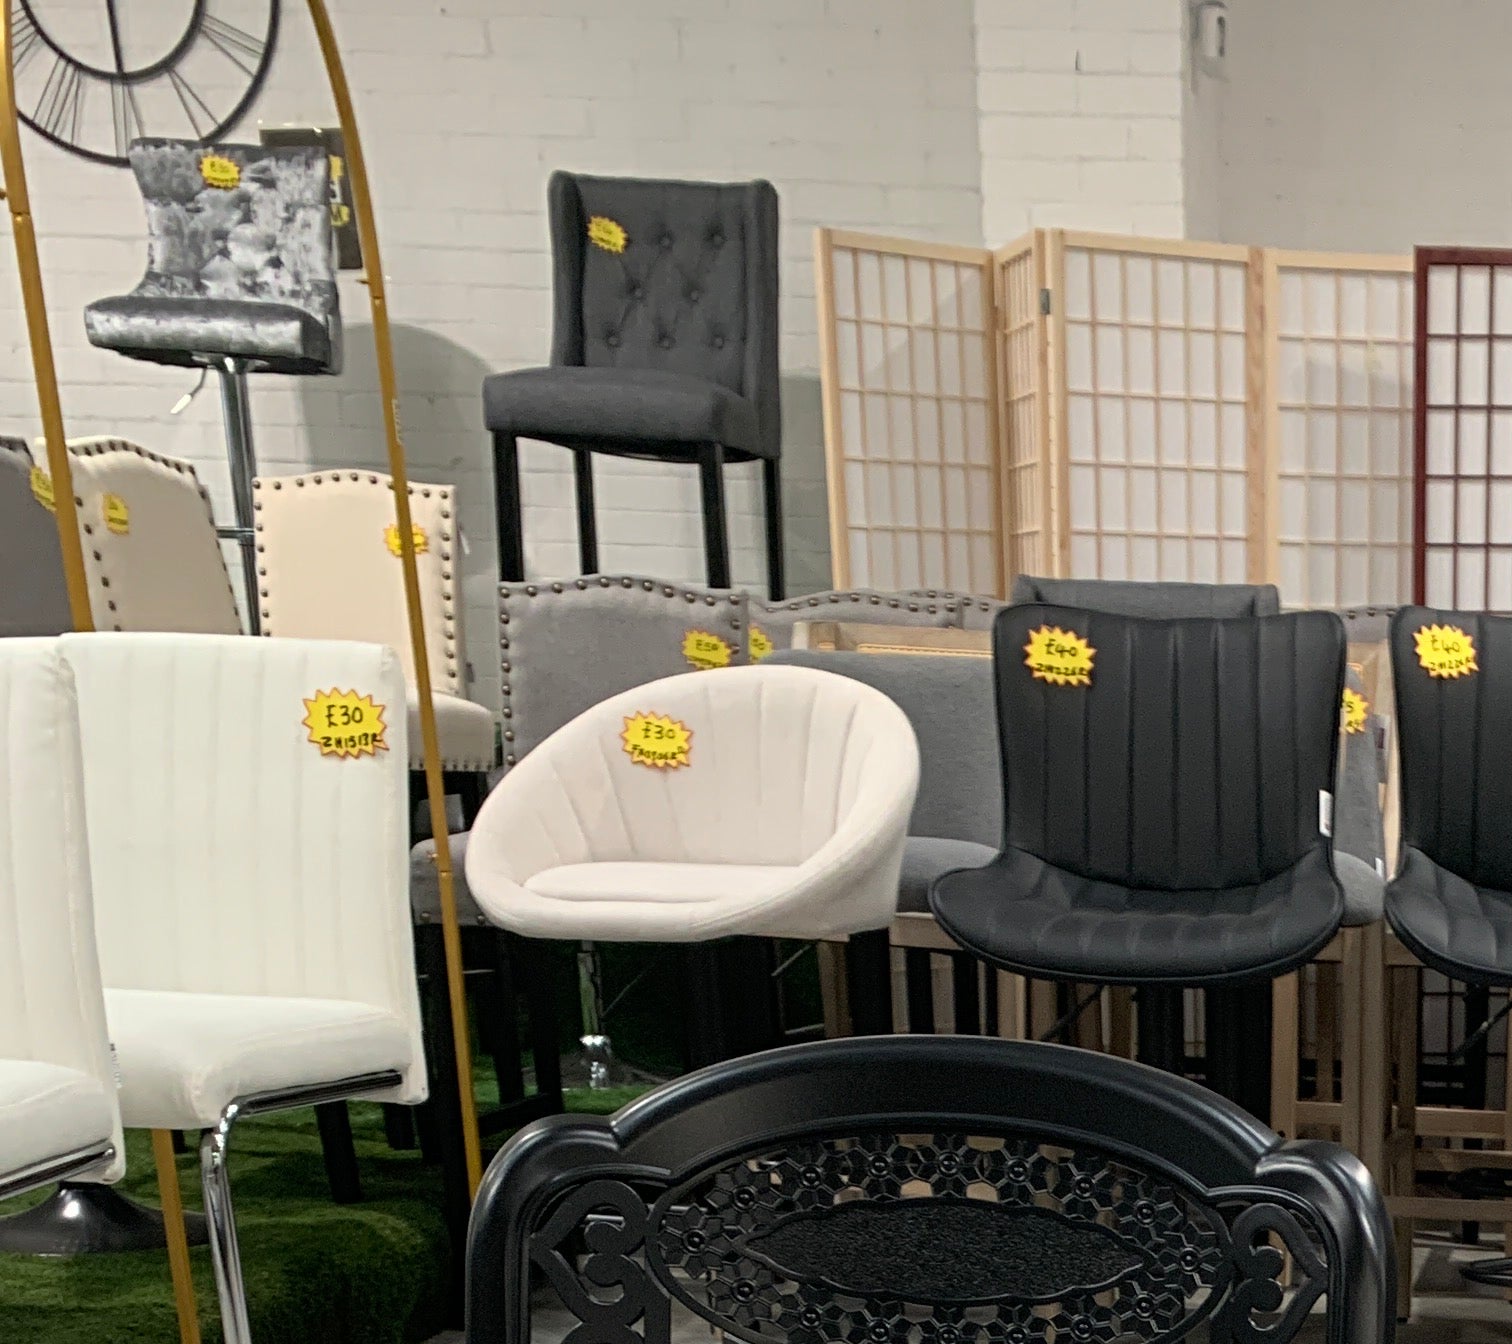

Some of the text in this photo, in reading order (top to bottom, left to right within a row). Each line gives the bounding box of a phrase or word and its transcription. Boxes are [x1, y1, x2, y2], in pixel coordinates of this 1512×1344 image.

[1044, 638, 1078, 658] £40
[325, 704, 363, 728] £30
[641, 721, 676, 739] £30
